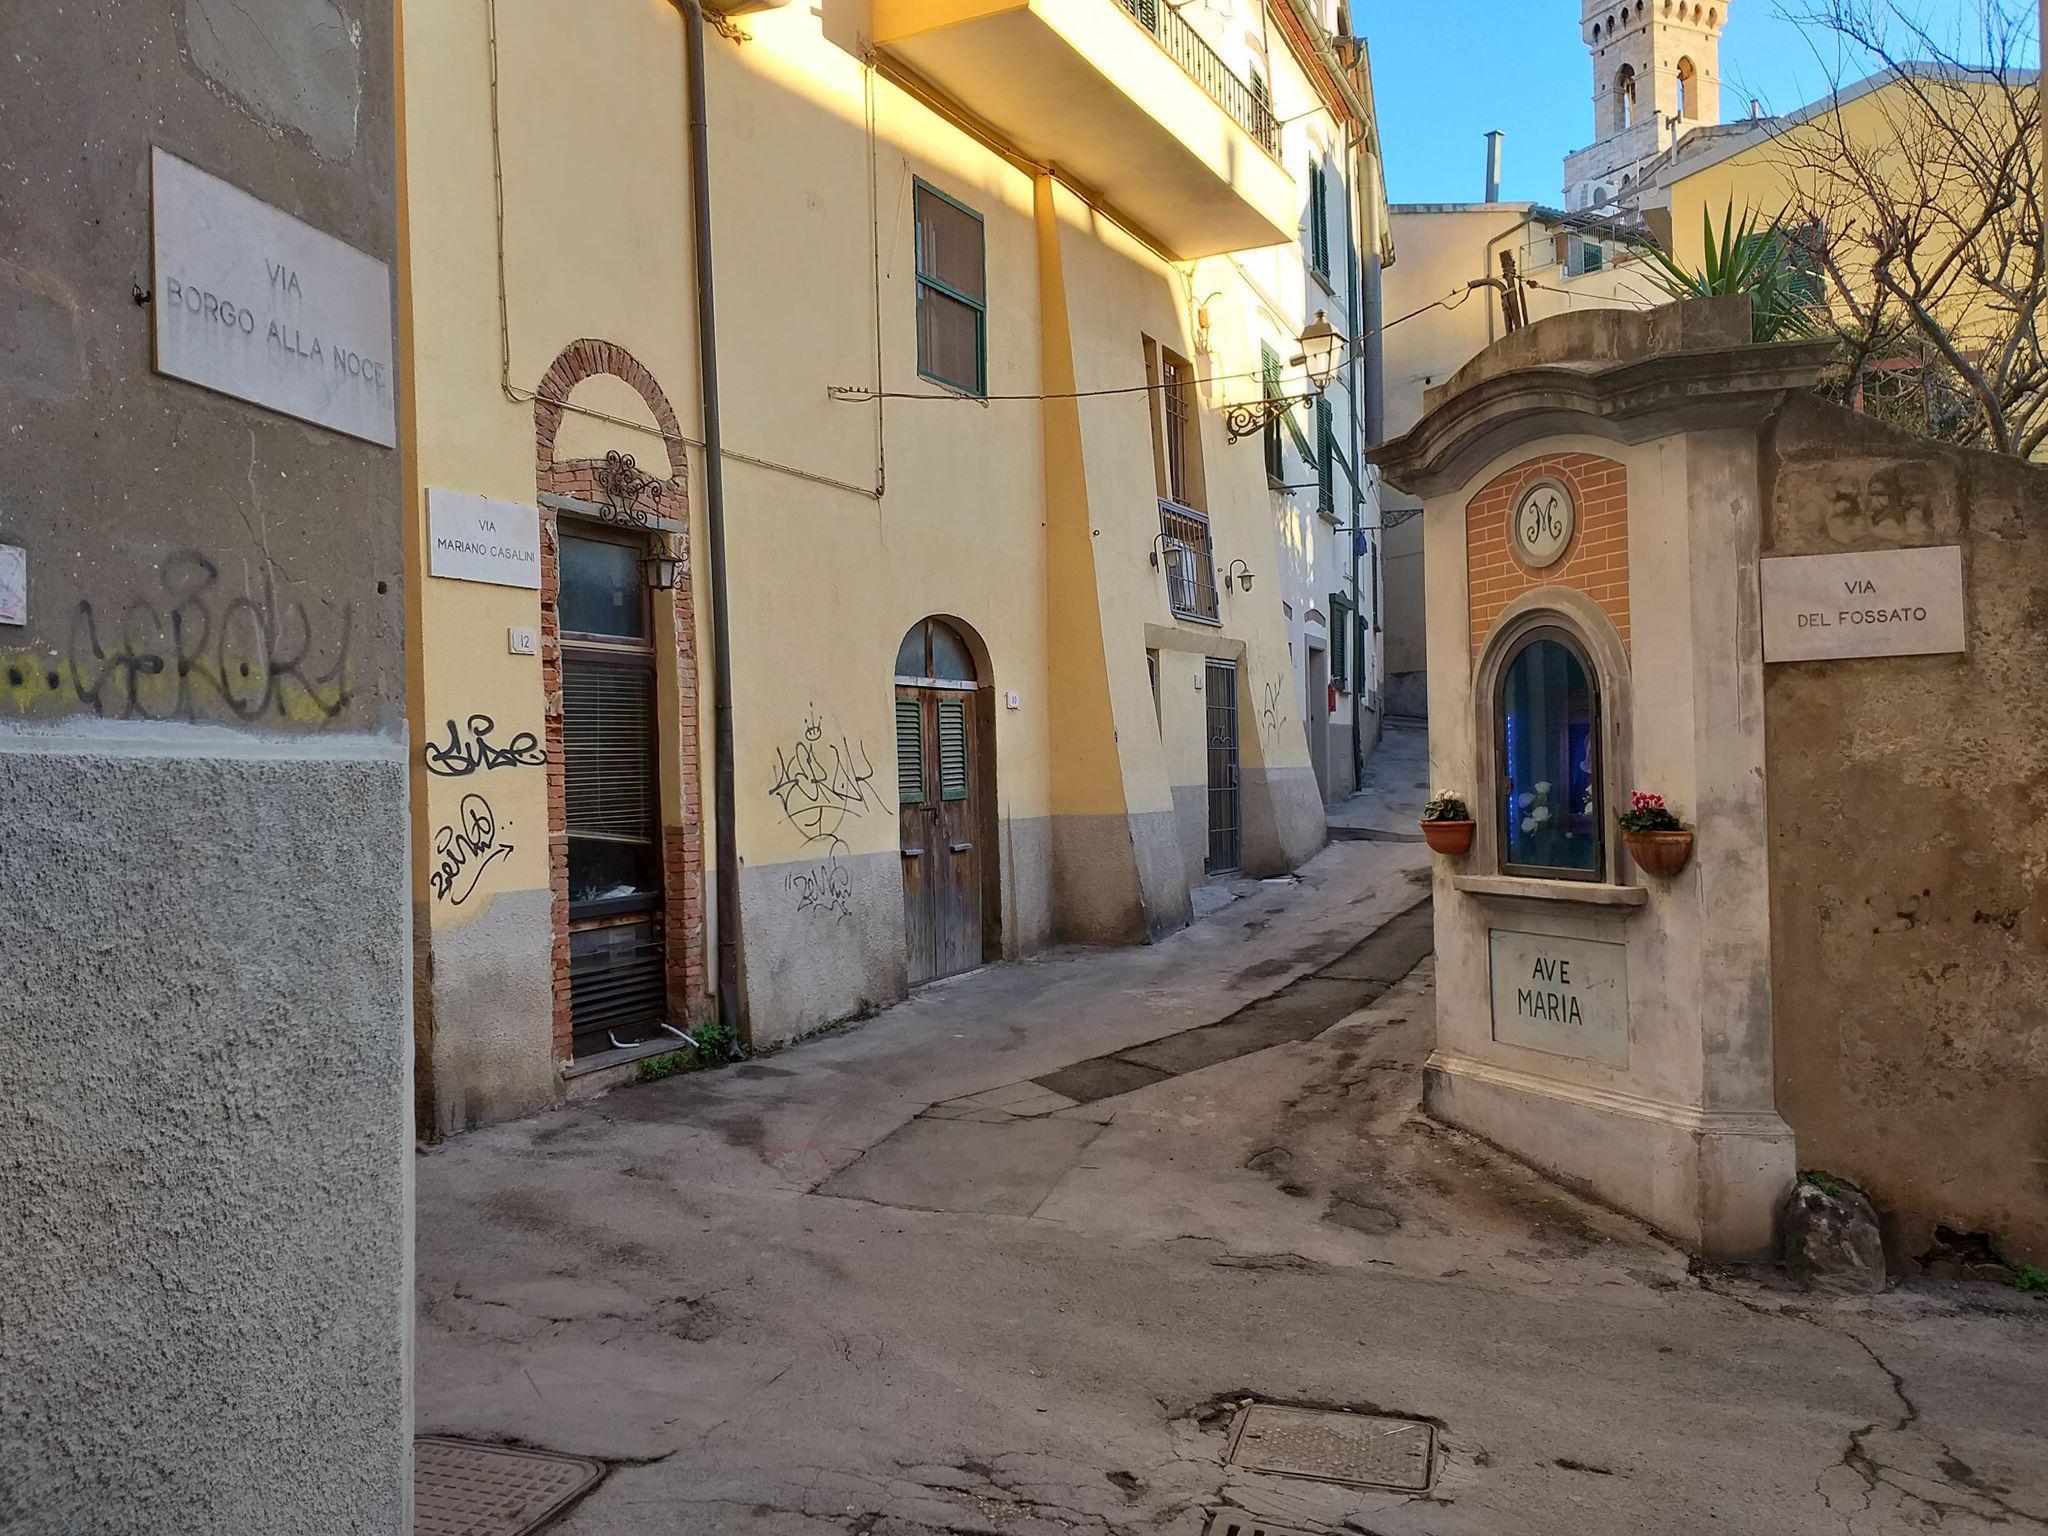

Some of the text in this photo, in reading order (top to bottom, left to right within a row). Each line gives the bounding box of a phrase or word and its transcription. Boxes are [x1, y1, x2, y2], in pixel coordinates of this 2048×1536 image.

[265, 258, 302, 299] VIA
[167, 275, 385, 390] BORGO ALLA NOCE
[478, 519, 497, 532] VIA
[437, 537, 535, 563] MARIANO CASALINI
[1844, 580, 1876, 595] VIA
[1798, 606, 1927, 628] DEL FOSSATO
[520, 634, 530, 649] 12
[1532, 957, 1571, 984] AVE
[1517, 988, 1583, 1026] MARIA
